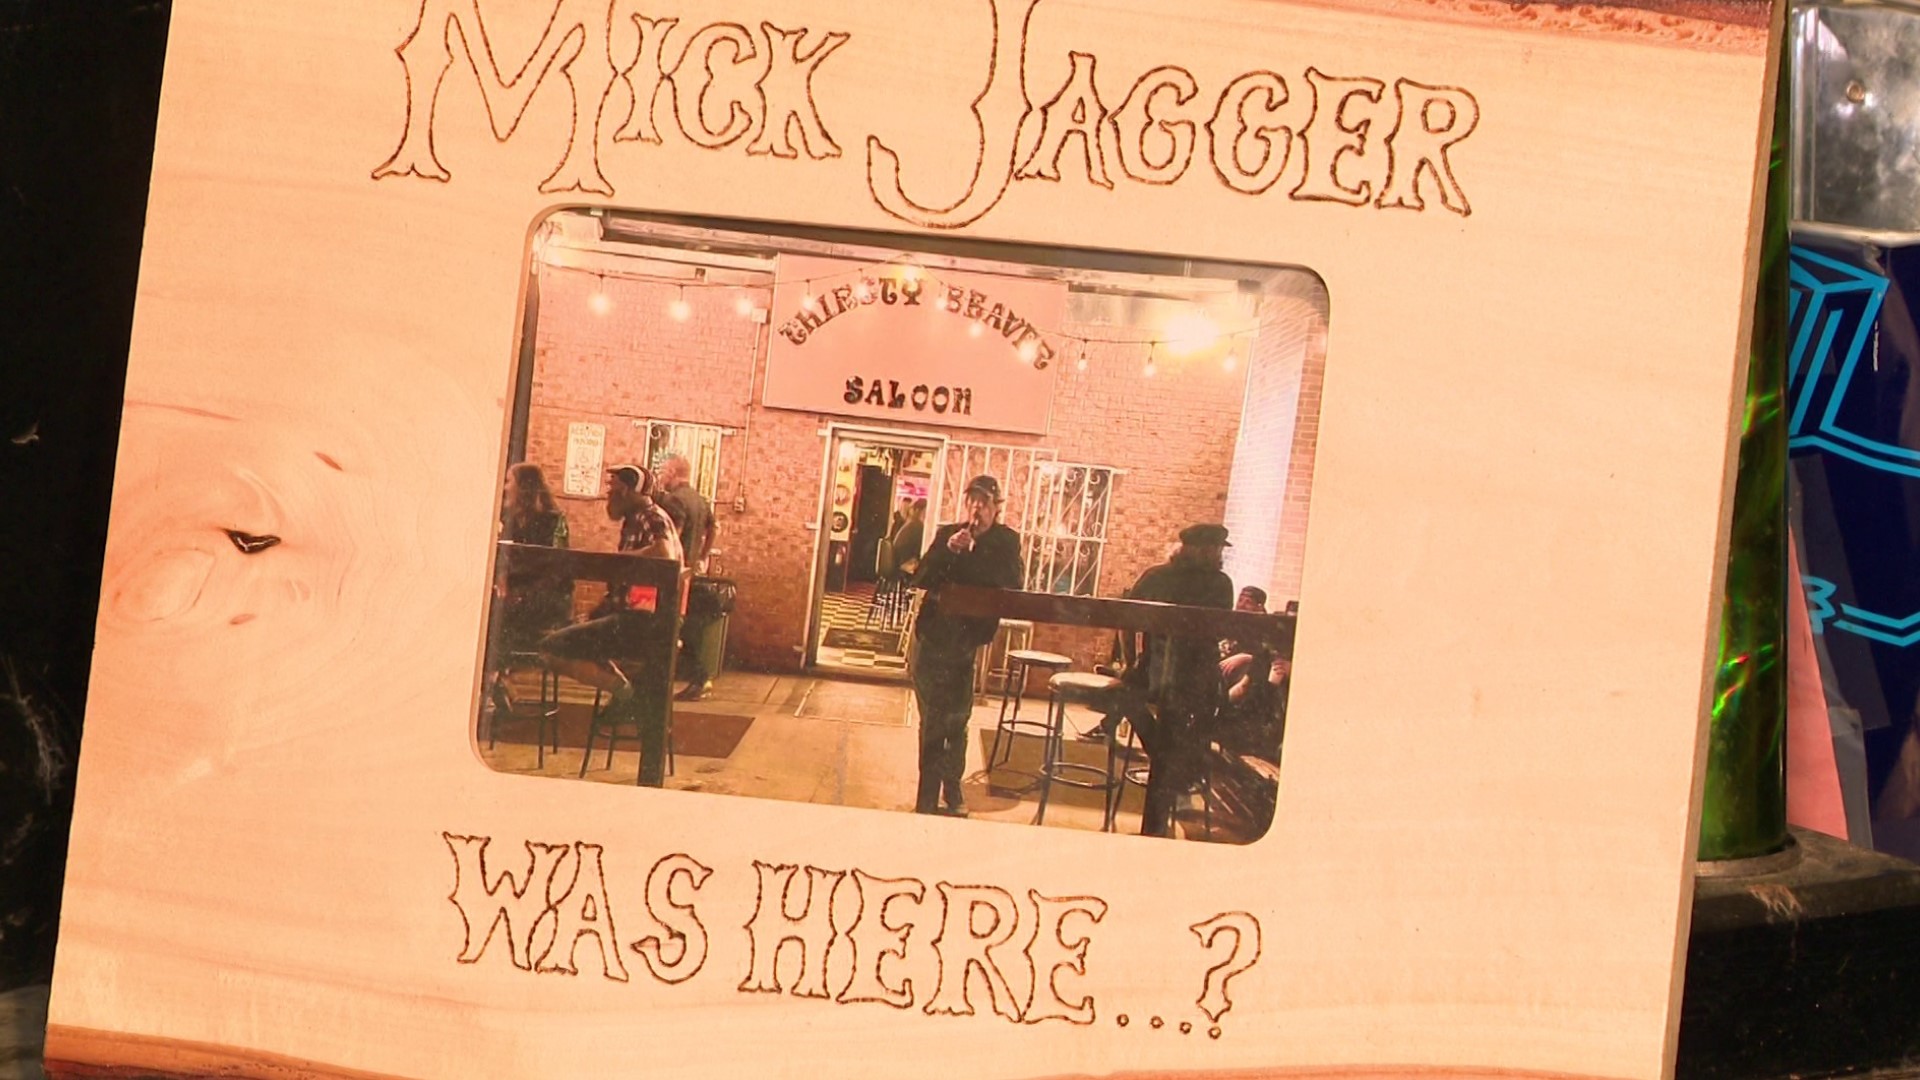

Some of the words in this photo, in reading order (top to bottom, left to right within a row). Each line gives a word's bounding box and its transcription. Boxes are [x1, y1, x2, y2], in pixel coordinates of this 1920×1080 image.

[372, 0, 851, 197] MICK
[867, 0, 1481, 229] JAGGER
[843, 375, 973, 416] SALOON
[443, 831, 711, 985] WAS
